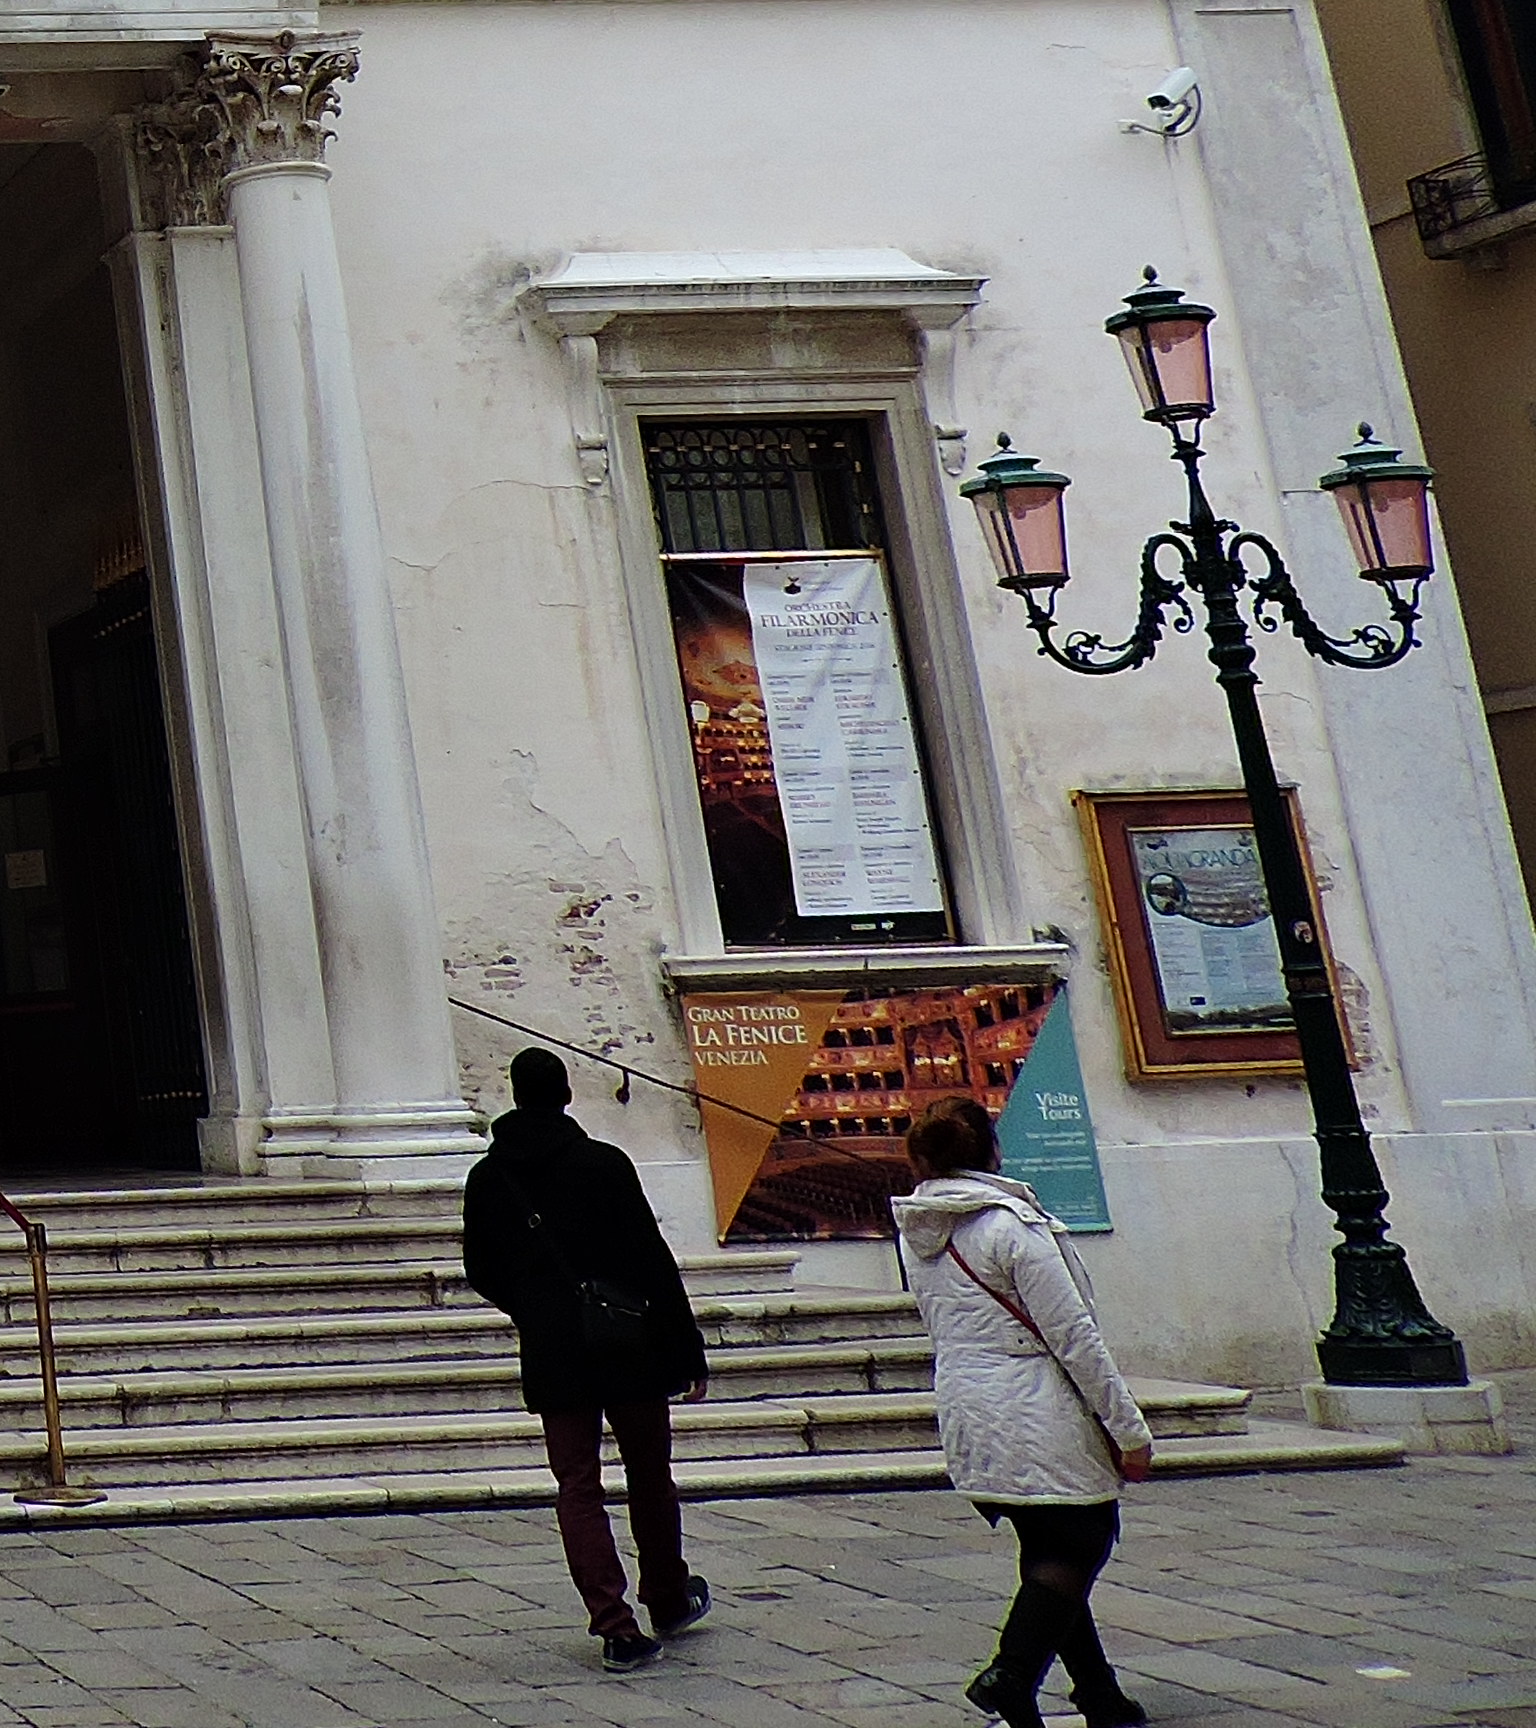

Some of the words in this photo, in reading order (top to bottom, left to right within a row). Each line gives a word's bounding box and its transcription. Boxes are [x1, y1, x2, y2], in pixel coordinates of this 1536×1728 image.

[761, 611, 879, 628] FILARMONICA
[688, 1006, 735, 1022] GRAN
[736, 1005, 800, 1021] TEATRO
[692, 1024, 723, 1047] LA
[725, 1023, 808, 1046] FENICE
[695, 1050, 769, 1066] VENEZIA
[1035, 1091, 1080, 1106] Visite
[1038, 1105, 1082, 1121] Tours
